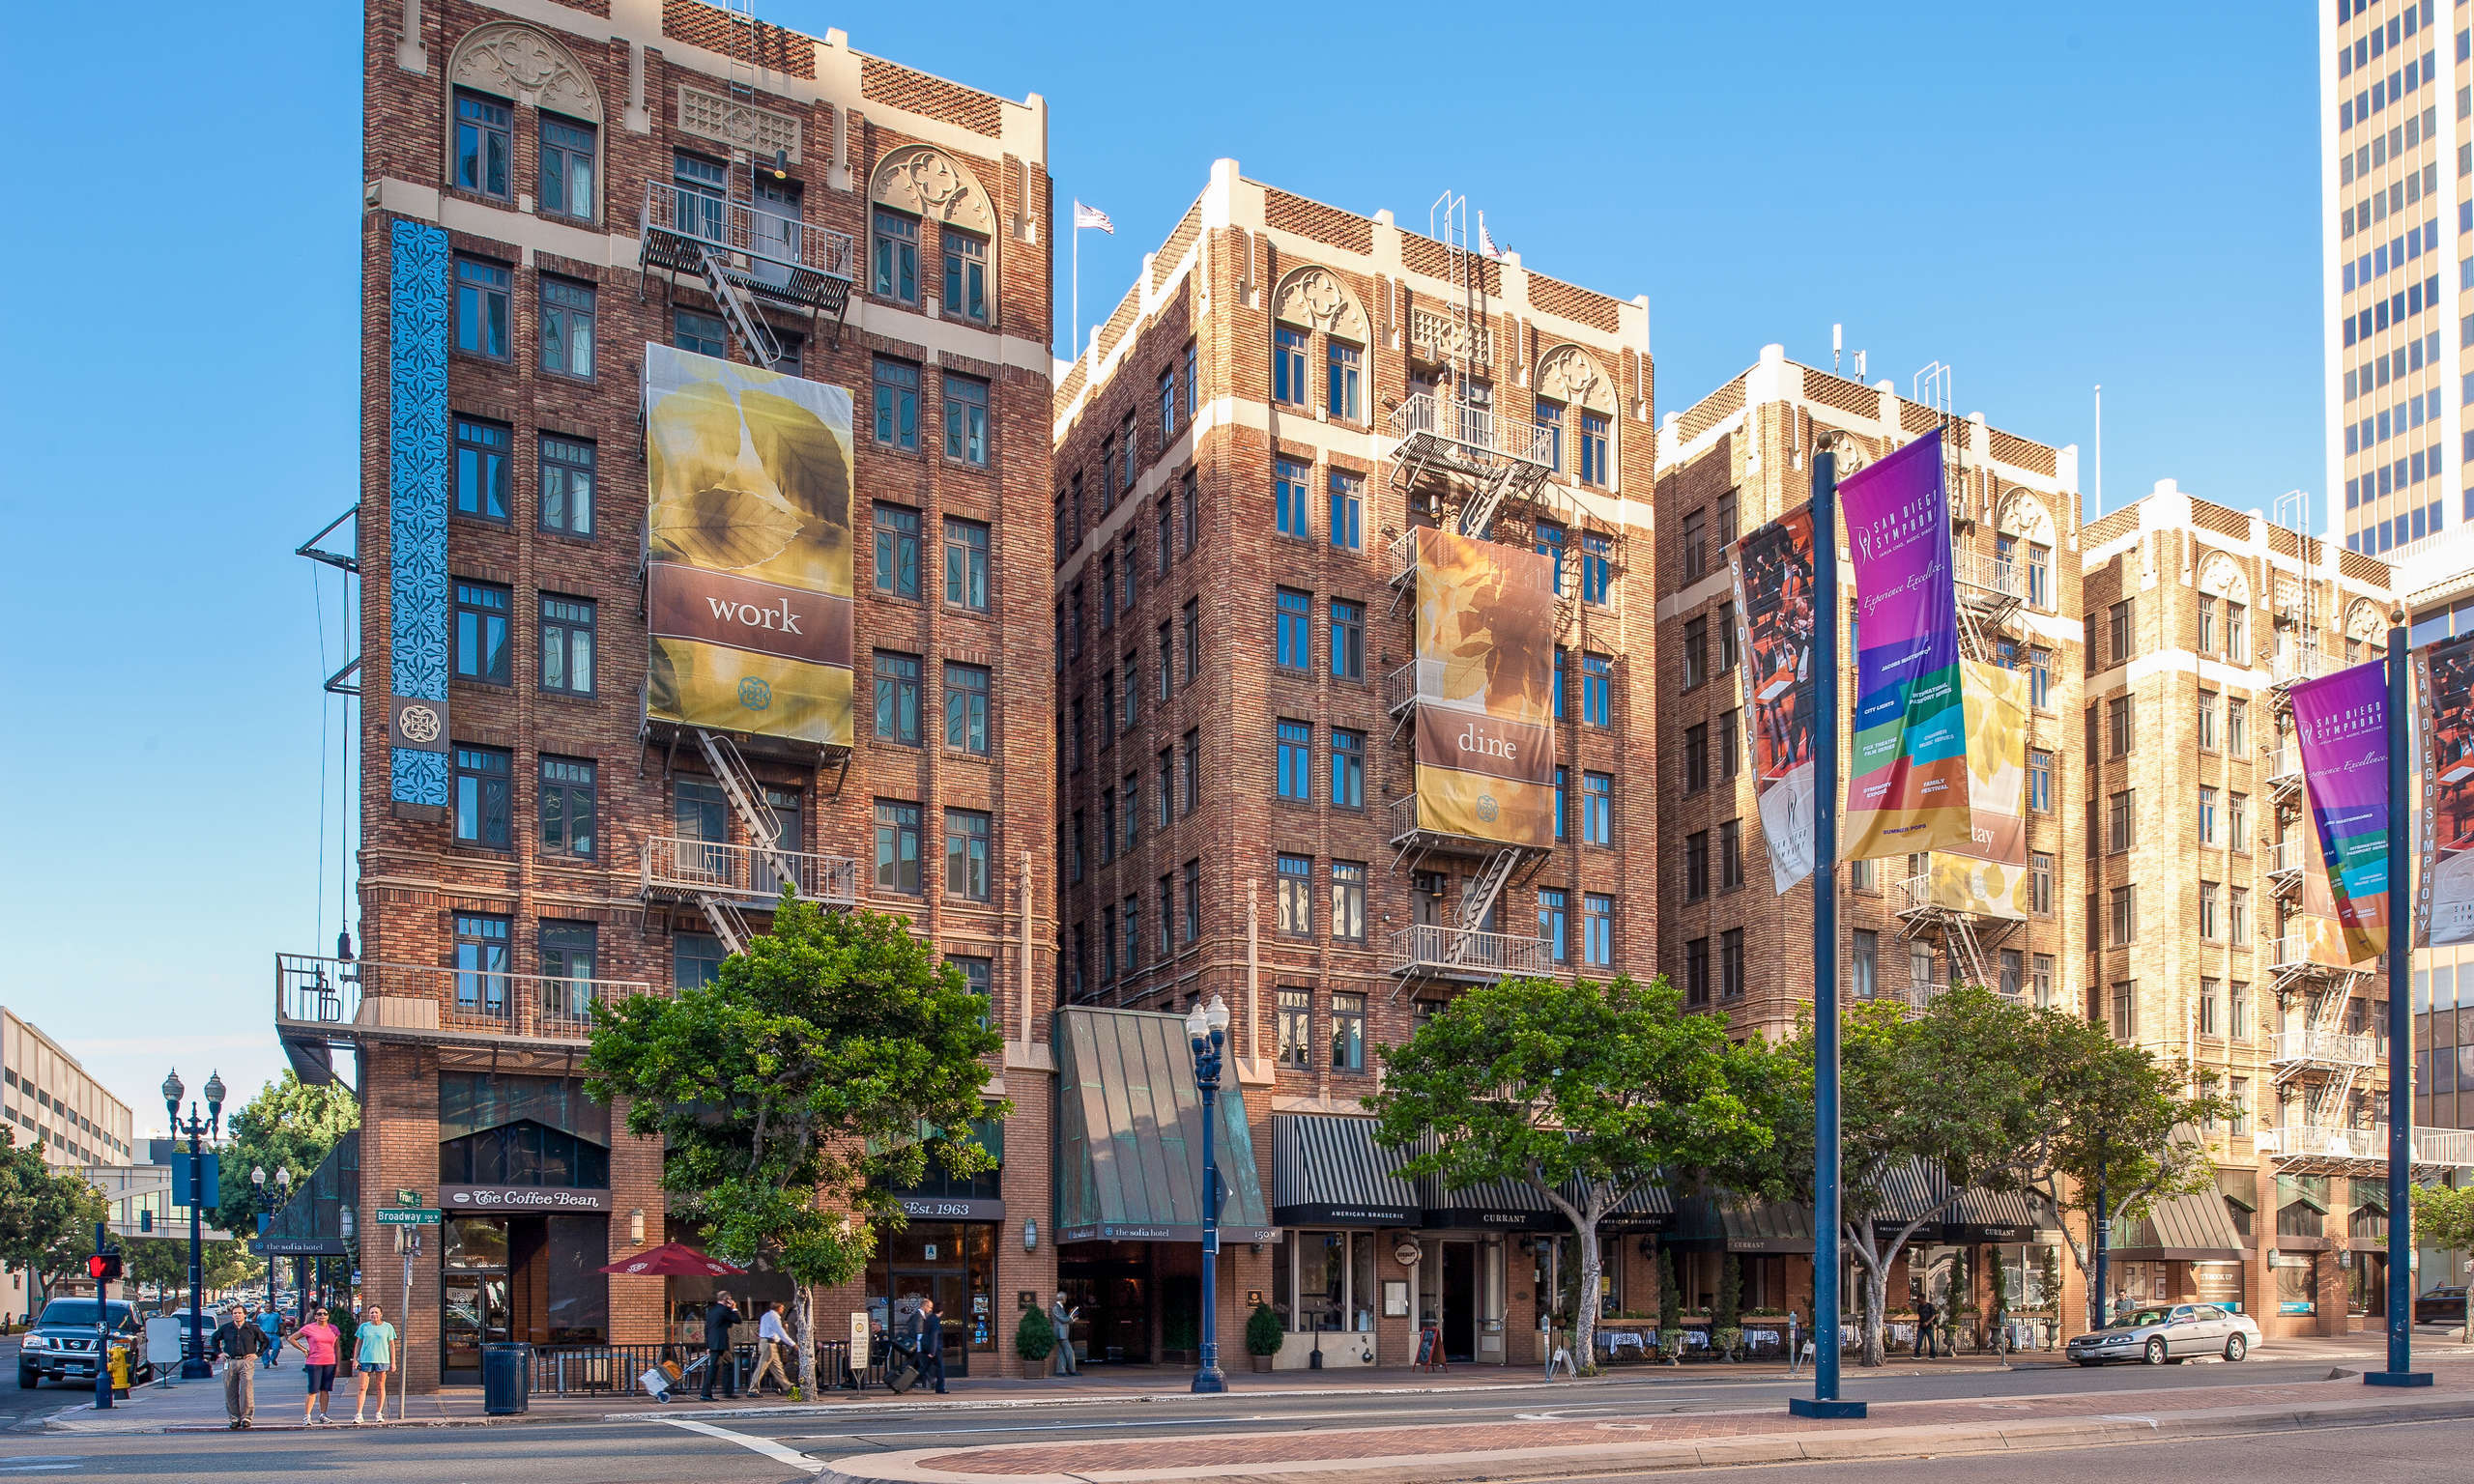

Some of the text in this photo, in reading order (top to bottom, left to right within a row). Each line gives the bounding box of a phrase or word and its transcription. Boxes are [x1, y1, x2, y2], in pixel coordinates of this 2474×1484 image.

[1874, 513, 1895, 533] SAN
[1864, 584, 1904, 616] Experience
[705, 596, 803, 635] work
[1731, 560, 1743, 614] SAN
[1738, 626, 1752, 719] DIEGO
[1864, 700, 1895, 715] CITY LIGHTS
[2316, 701, 2381, 728] SAN DIEGO
[2317, 713, 2382, 739] SYMPHONY
[1457, 723, 1517, 760] dine
[1923, 778, 1945, 787] FAMILY
[2417, 661, 2434, 932] SAN DIEGO SYMPHONY
[1883, 826, 1910, 835] SUMMER
[1971, 823, 1995, 853] tay
[399, 1191, 414, 1204] Front
[473, 1190, 599, 1208] The Coffee Bean
[904, 1201, 969, 1215] Est. 1963
[378, 1211, 421, 1223] Broadway
[1483, 1213, 1526, 1223] CURRANT
[1130, 1228, 1149, 1237] sofia
[1150, 1228, 1169, 1237] hotel
[1254, 1231, 1270, 1240] 150
[1985, 1228, 2015, 1237] CURRANT
[302, 1242, 323, 1251] hotel
